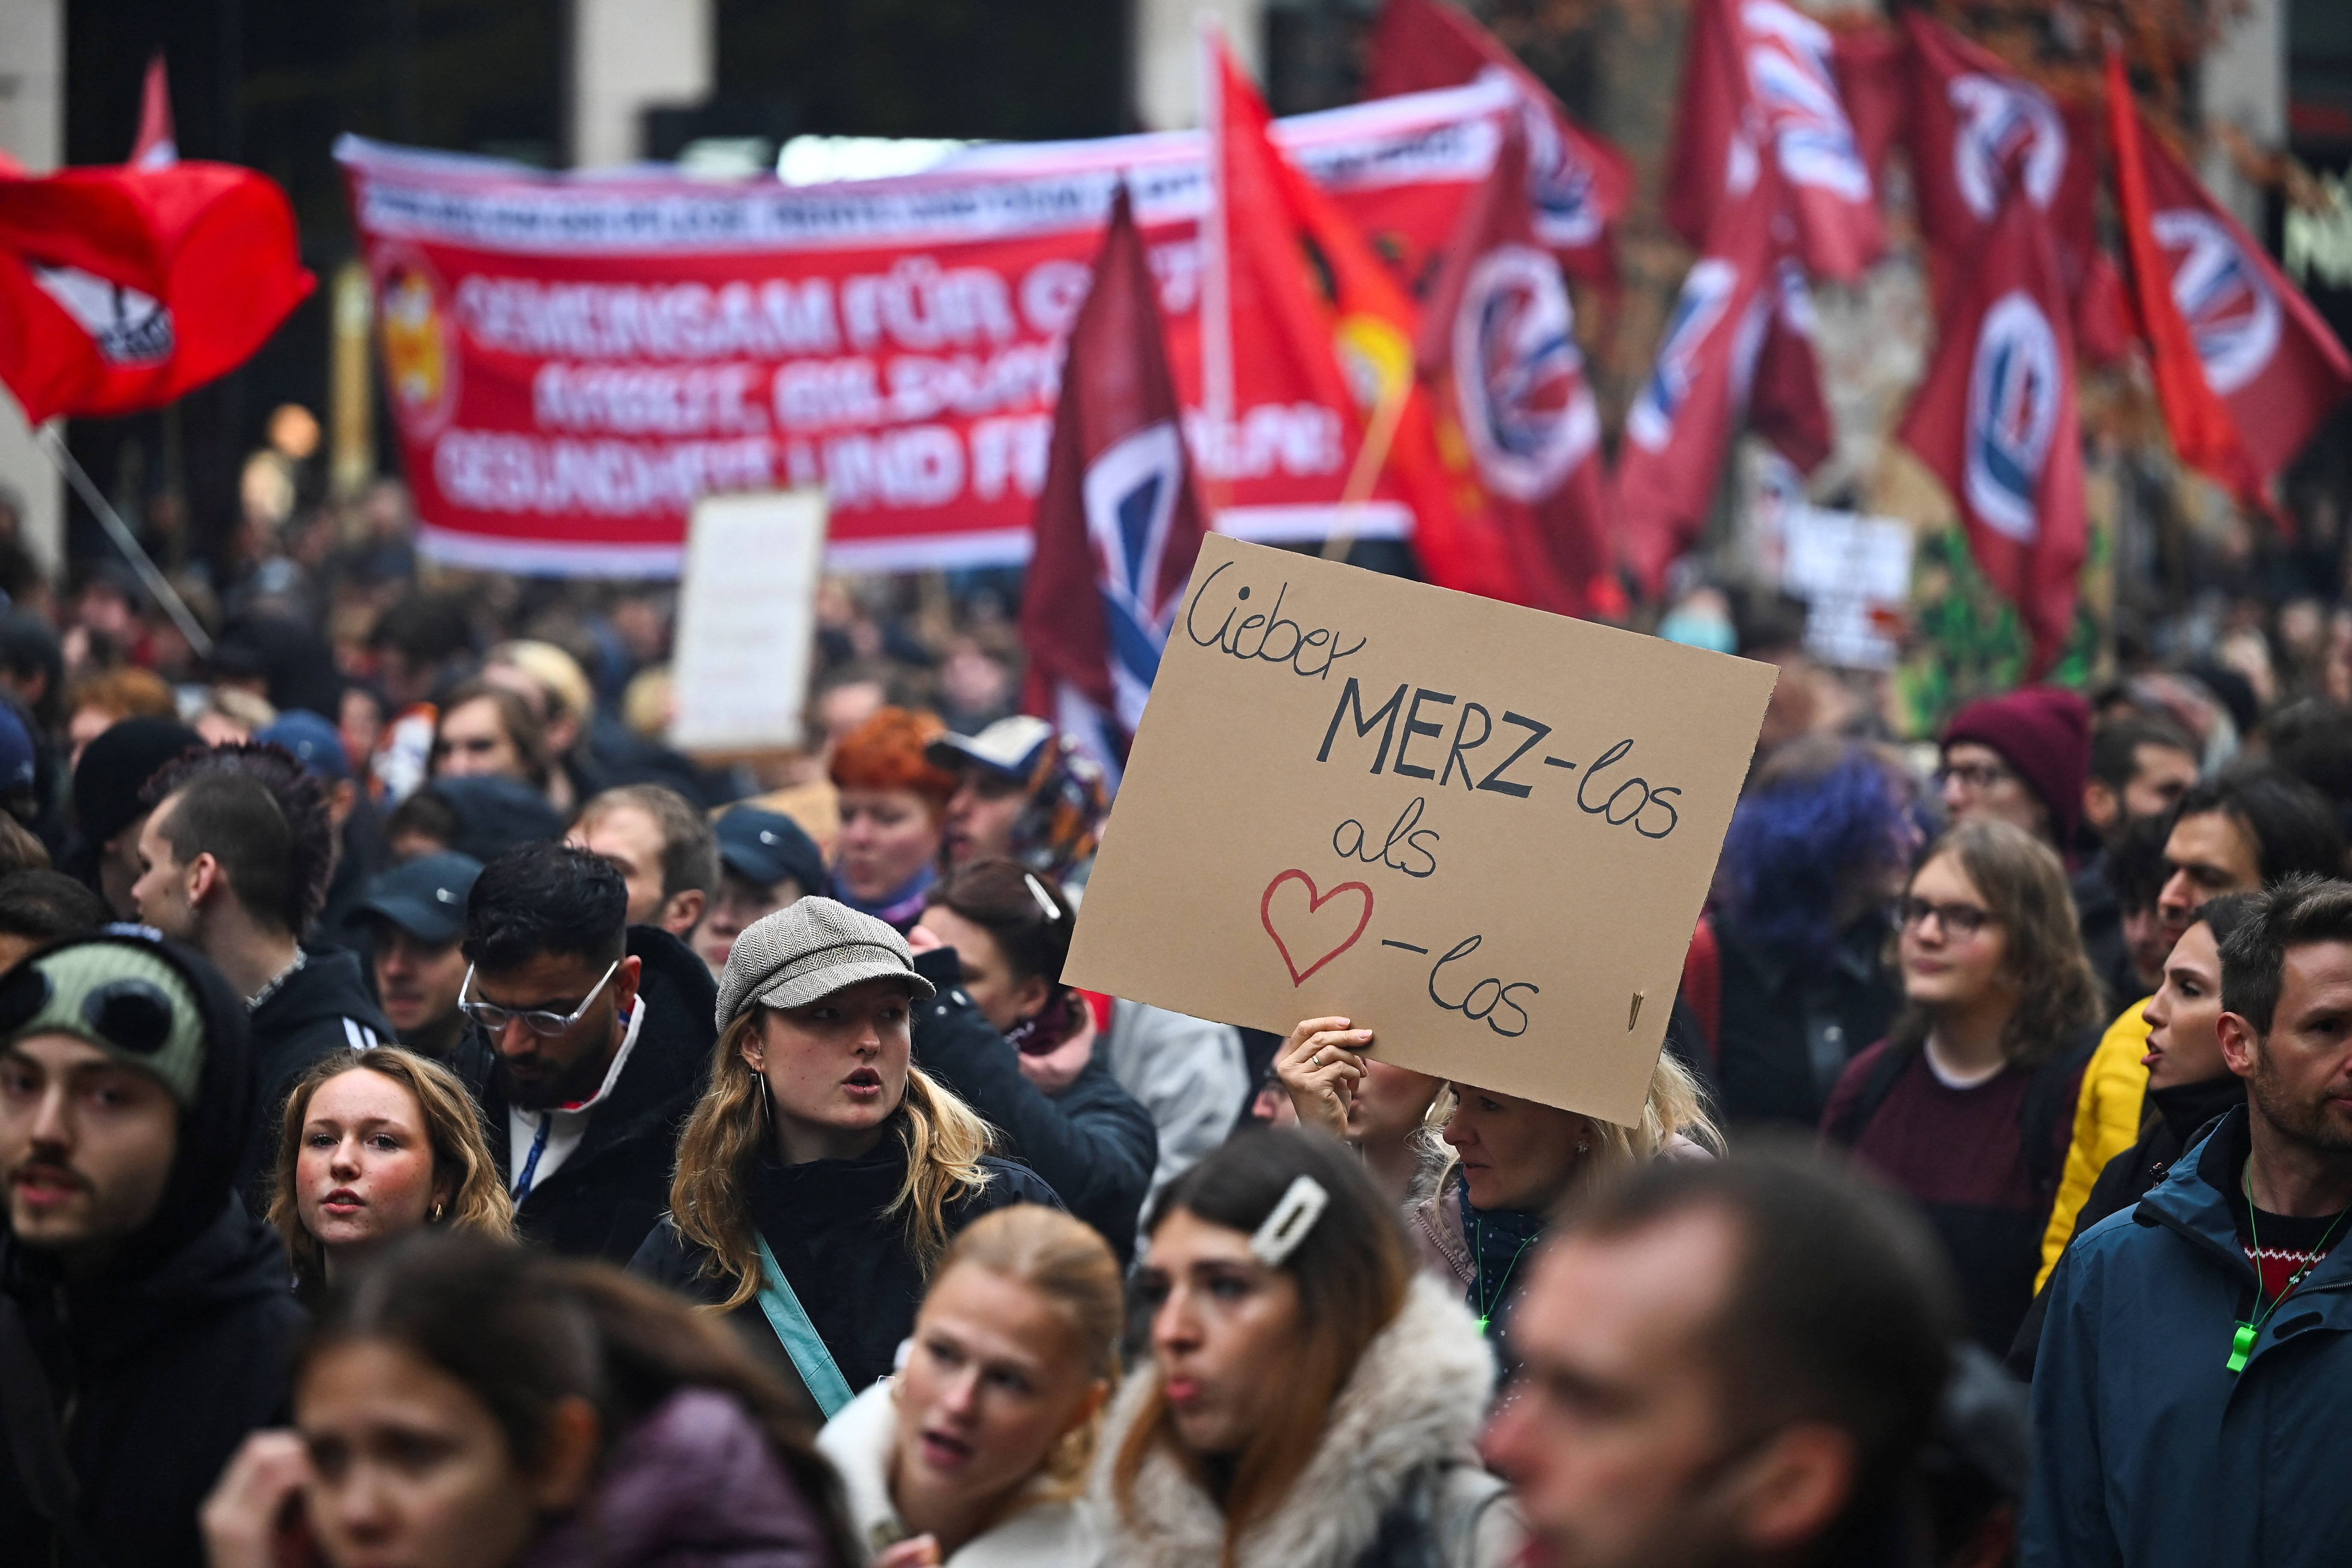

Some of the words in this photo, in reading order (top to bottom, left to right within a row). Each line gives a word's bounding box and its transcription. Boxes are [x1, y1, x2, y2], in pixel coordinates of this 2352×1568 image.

[840, 255, 1016, 351] FÜR
[1315, 676, 1682, 839] MERZ-los
[1333, 796, 1440, 878] als
